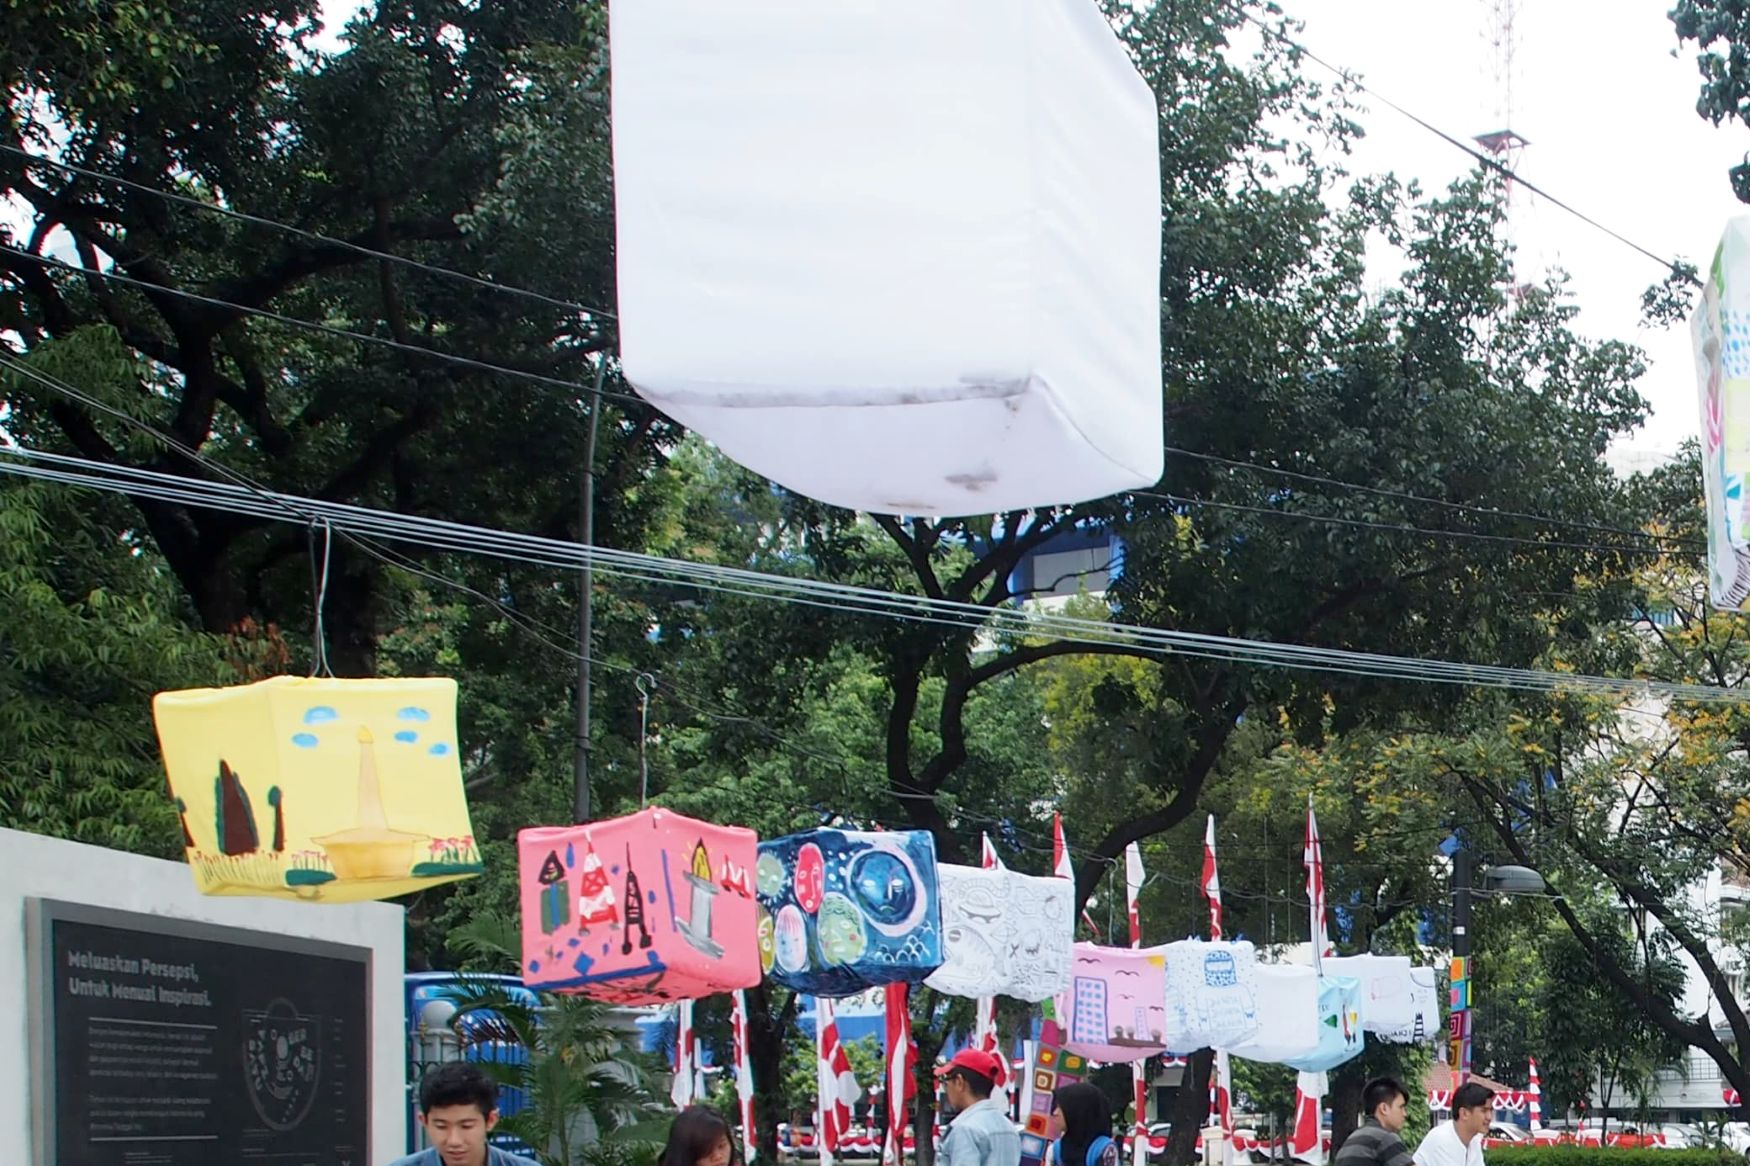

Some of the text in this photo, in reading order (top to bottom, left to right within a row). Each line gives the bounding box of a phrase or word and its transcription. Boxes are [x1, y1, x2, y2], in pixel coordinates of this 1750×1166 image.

[68, 950, 199, 983] Meluaskan Persepsi,
[69, 977, 110, 998] Untuk
[159, 987, 212, 1007] Inspirasi.
